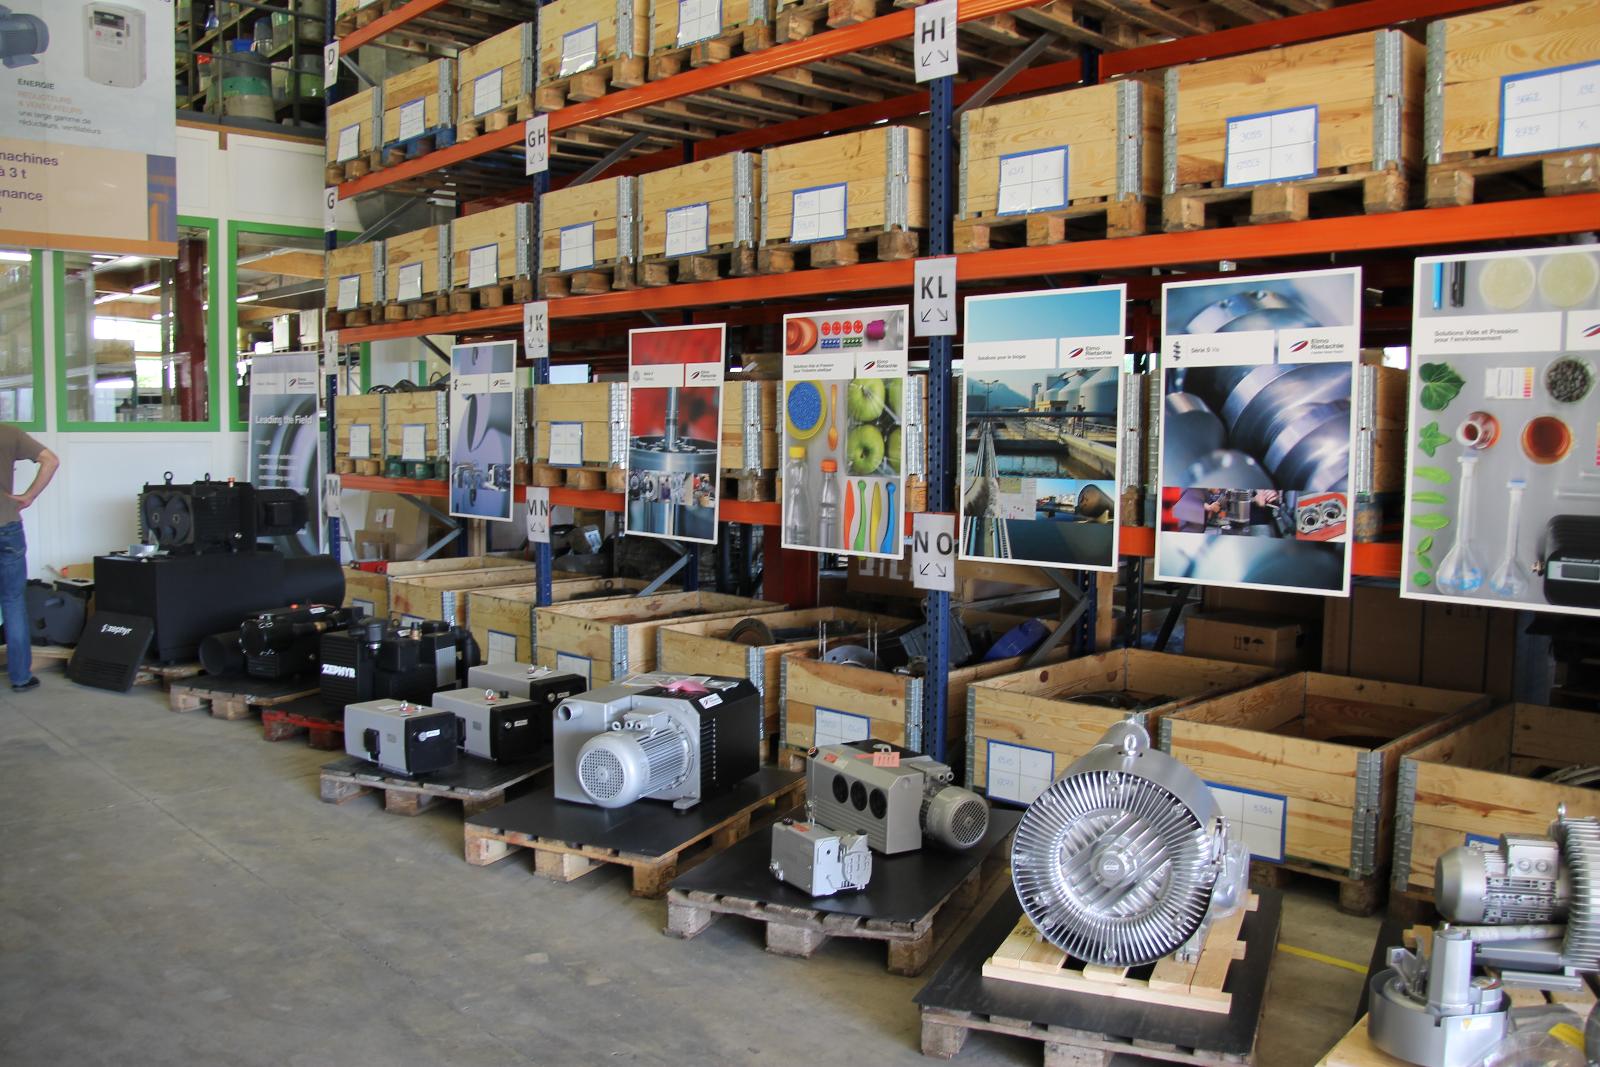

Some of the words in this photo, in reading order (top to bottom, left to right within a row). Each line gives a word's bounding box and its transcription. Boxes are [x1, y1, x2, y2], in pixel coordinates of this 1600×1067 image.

[921, 19, 946, 44] HI
[328, 48, 335, 66] D
[527, 127, 546, 148] GH
[9, 167, 18, 178] 3
[21, 169, 27, 179] t
[0, 189, 44, 201] nance
[327, 192, 335, 210] G
[920, 276, 948, 300] KL
[255, 415, 282, 426] Leading
[283, 415, 294, 424] the
[294, 415, 313, 424] Field
[328, 479, 338, 497] M
[321, 663, 356, 679] ZEPHYR
